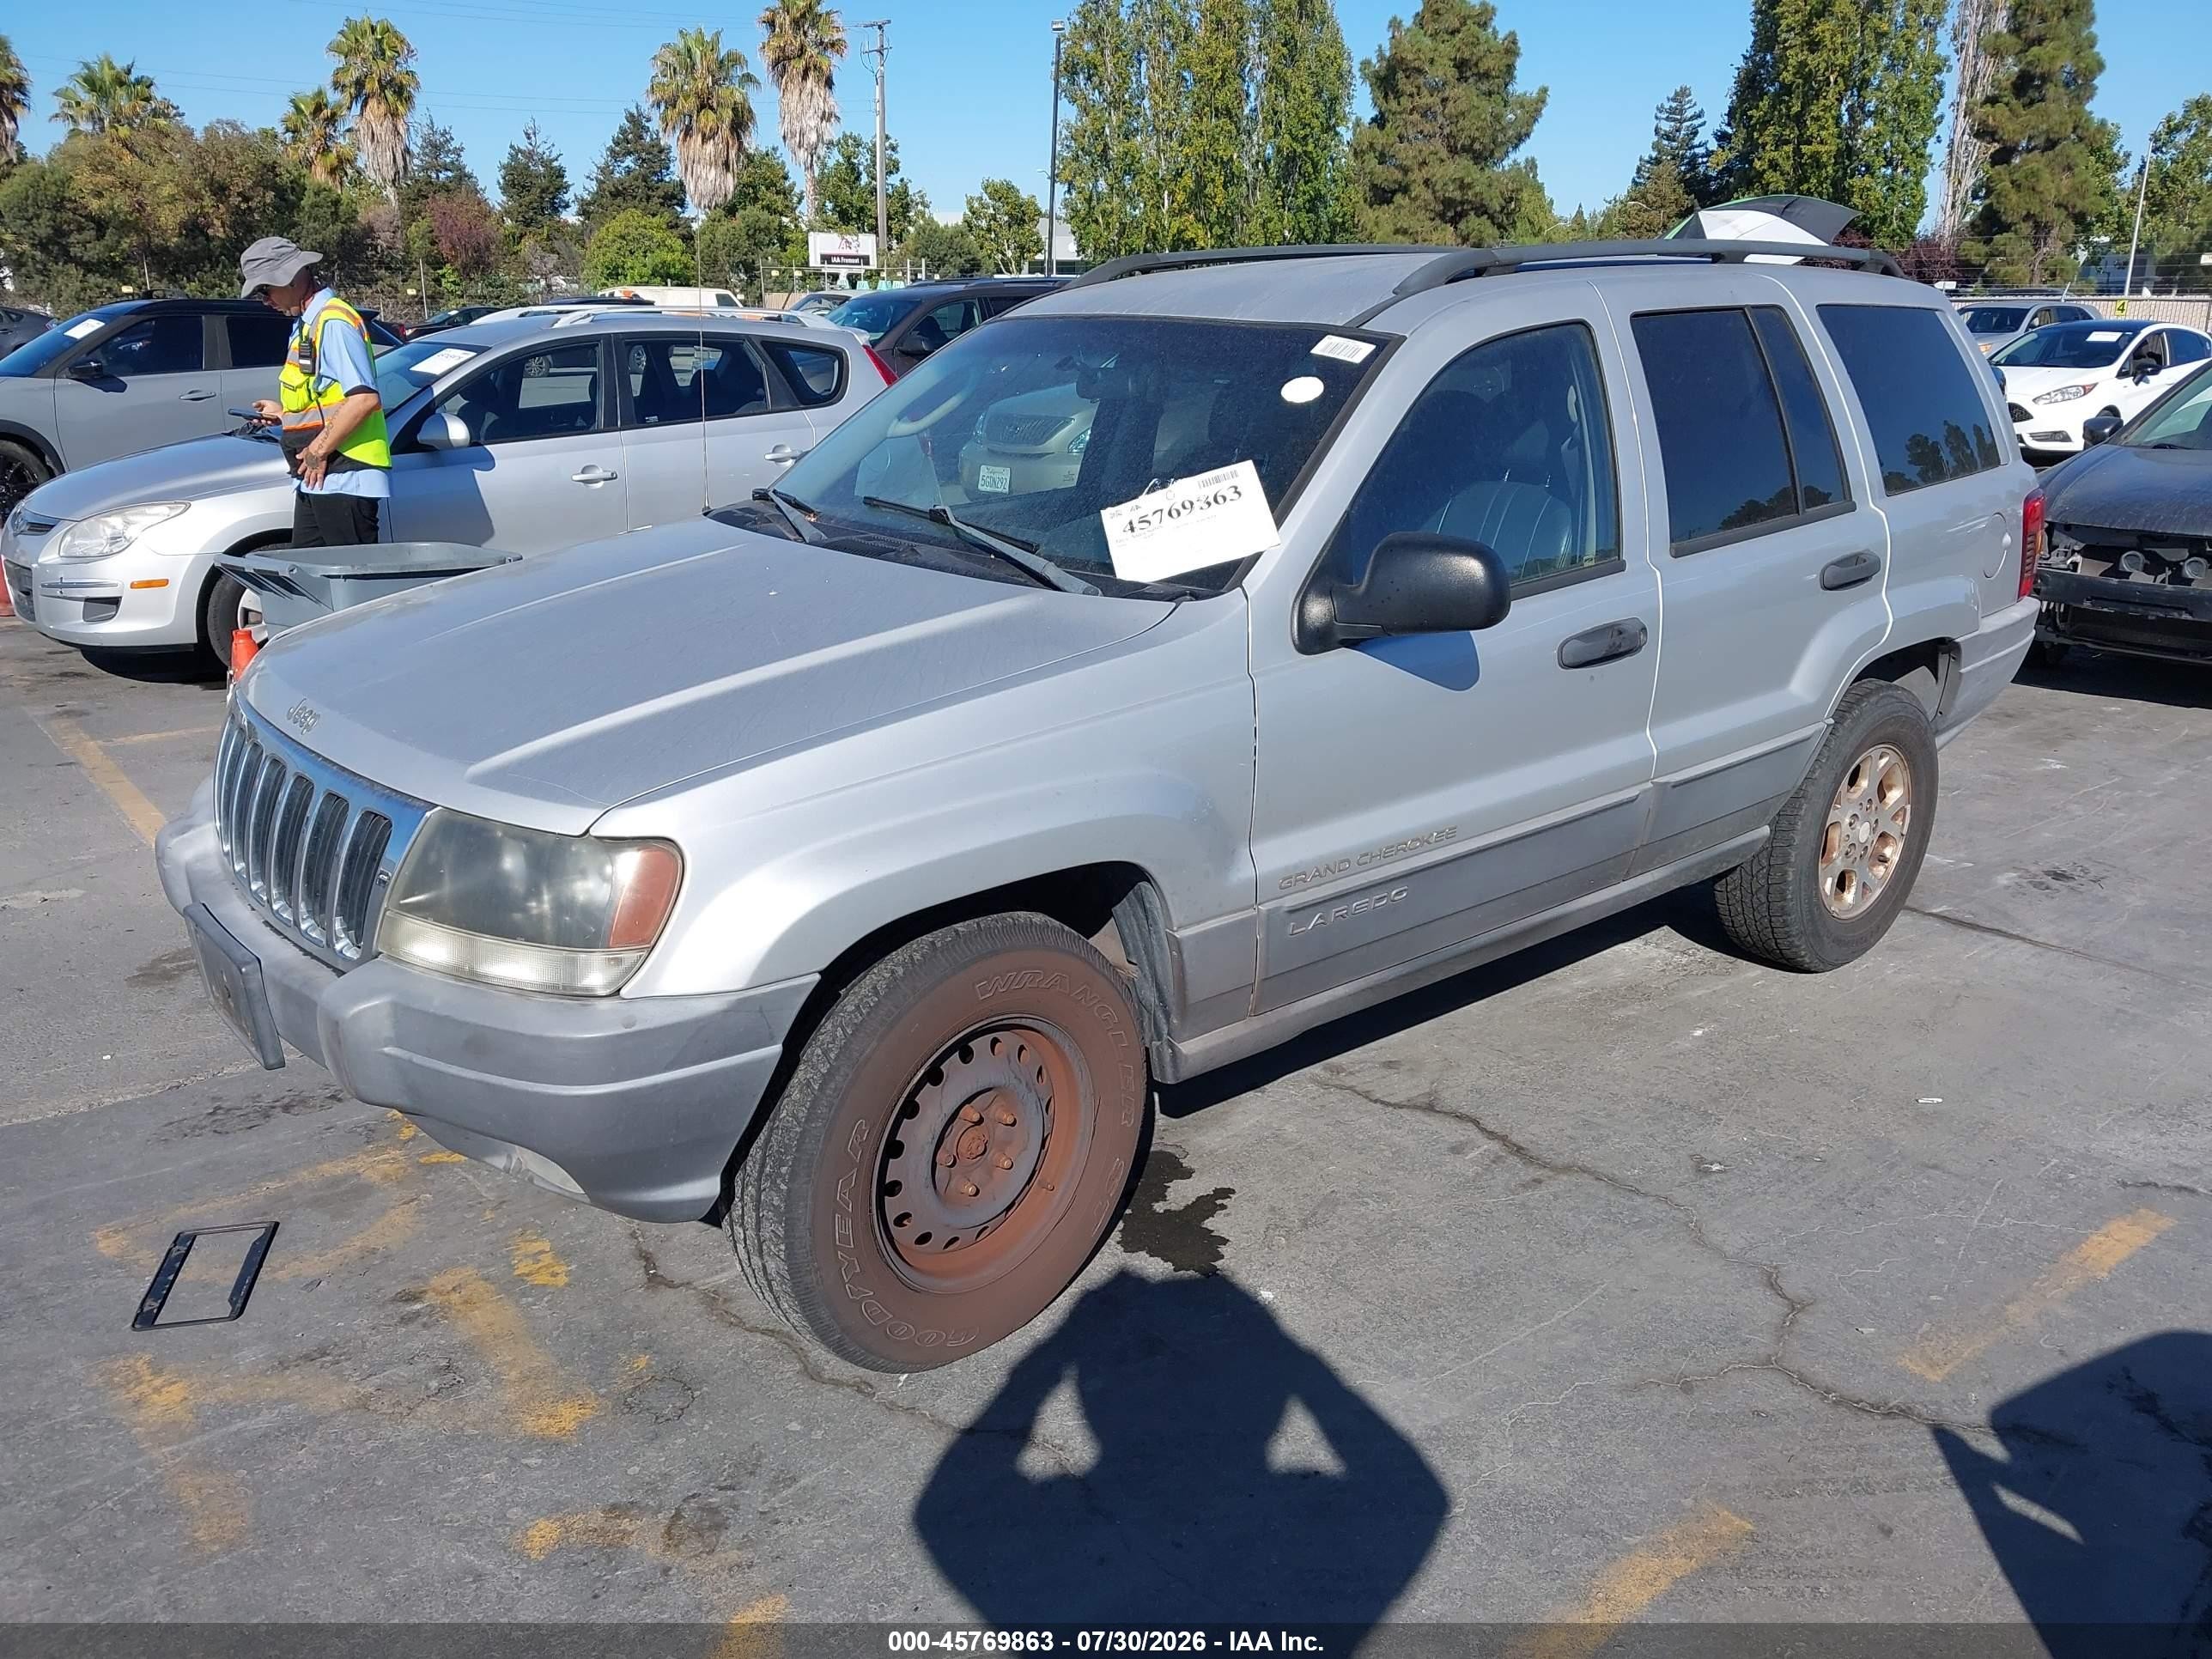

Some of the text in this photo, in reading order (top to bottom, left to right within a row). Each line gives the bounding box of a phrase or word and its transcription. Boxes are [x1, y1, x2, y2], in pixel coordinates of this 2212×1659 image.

[2117, 301, 2125, 313] 4
[288, 698, 320, 735] Jeep
[1278, 825, 1458, 890] GRAND CHEROKEE
[1288, 884, 1409, 937] LAREDO
[976, 969, 1135, 1128] WRANGLER
[830, 1118, 981, 1346] GOODYEAR
